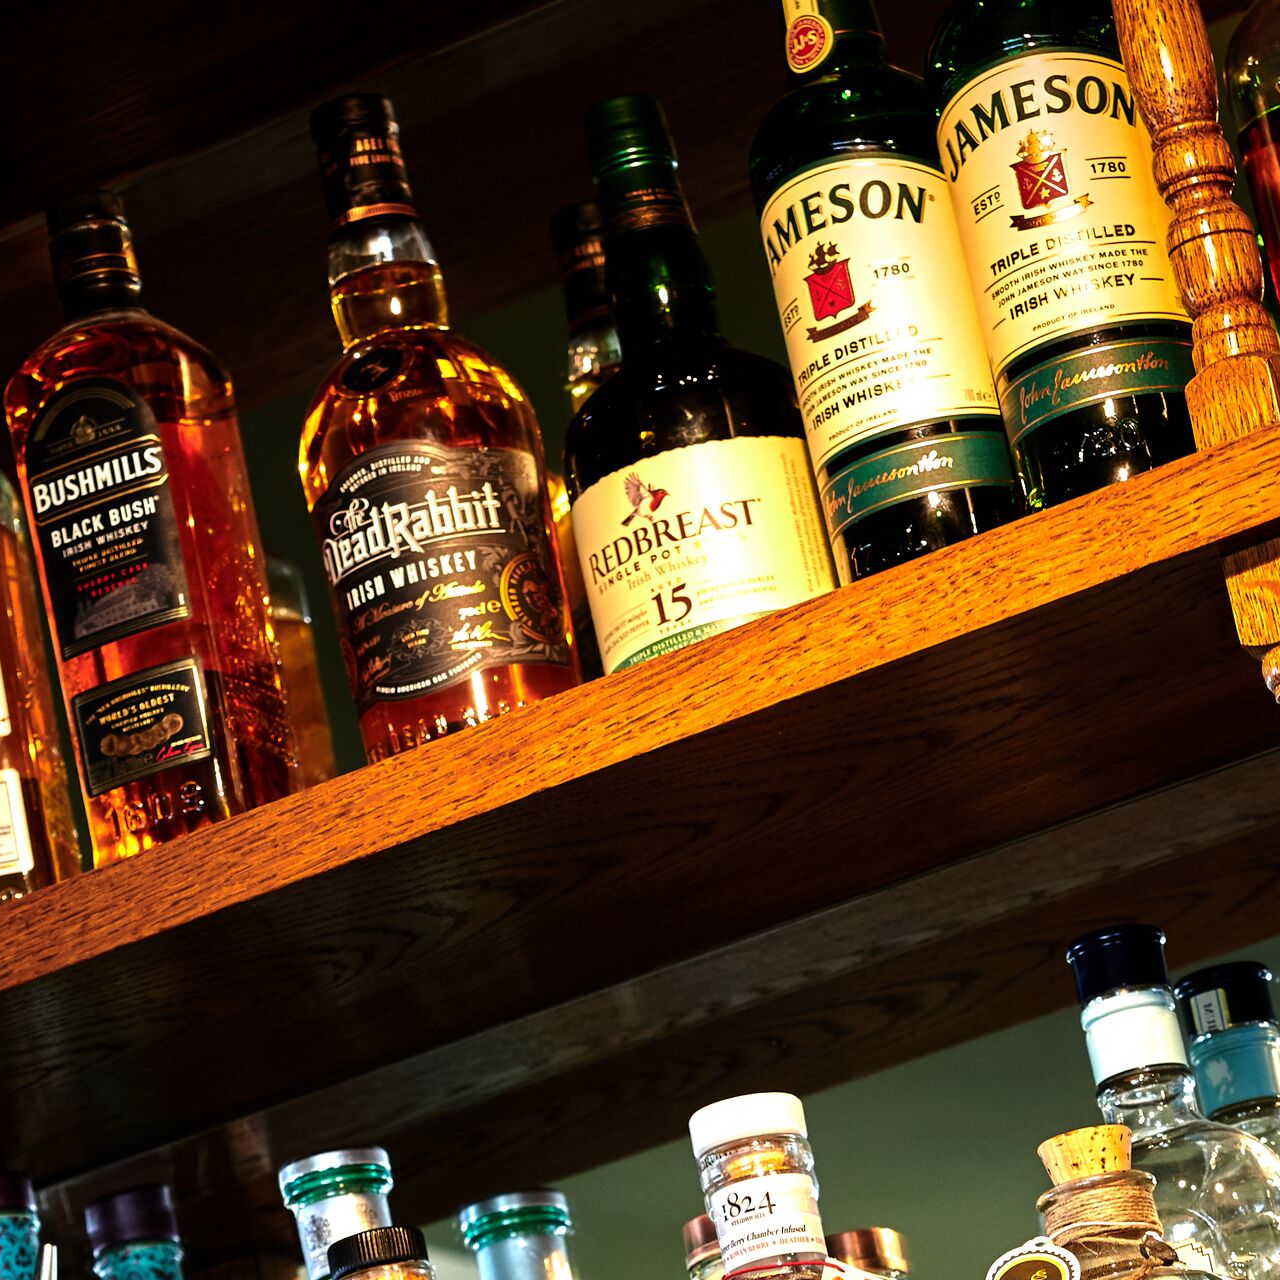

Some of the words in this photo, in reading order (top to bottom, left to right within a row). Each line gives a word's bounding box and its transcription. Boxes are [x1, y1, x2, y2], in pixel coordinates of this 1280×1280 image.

[945, 74, 1137, 183] JAMESON
[1090, 161, 1126, 174] 1780
[990, 242, 1040, 277] TRIPLE
[1099, 248, 1127, 258] MADE
[873, 262, 910, 279] 1780
[1009, 293, 1049, 321] IRISH
[839, 361, 878, 380] WHISKEY
[816, 383, 847, 408] JAMESON
[849, 375, 869, 386] WAY
[812, 401, 840, 430] IRISH
[33, 447, 162, 514] BUSHMILLS
[50, 514, 105, 548] BLACK
[108, 497, 156, 527] BUSH
[323, 506, 390, 586] Dead
[381, 482, 502, 558] Rabbit
[63, 541, 93, 559] IRISH
[96, 521, 149, 544] WHISKEY
[588, 499, 756, 586] REDBREAST
[346, 575, 386, 611] IRISH
[389, 550, 476, 589] WHISKEY
[598, 562, 640, 595] SINGLE
[650, 545, 682, 565] POT
[627, 574, 652, 591] Irish
[651, 583, 693, 627] 15
[721, 1191, 776, 1222] 1824
[730, 1237, 745, 1250] Berry
[747, 1228, 779, 1242] Chamber
[781, 1224, 806, 1234] Infused
[748, 1241, 769, 1252] BERRY
